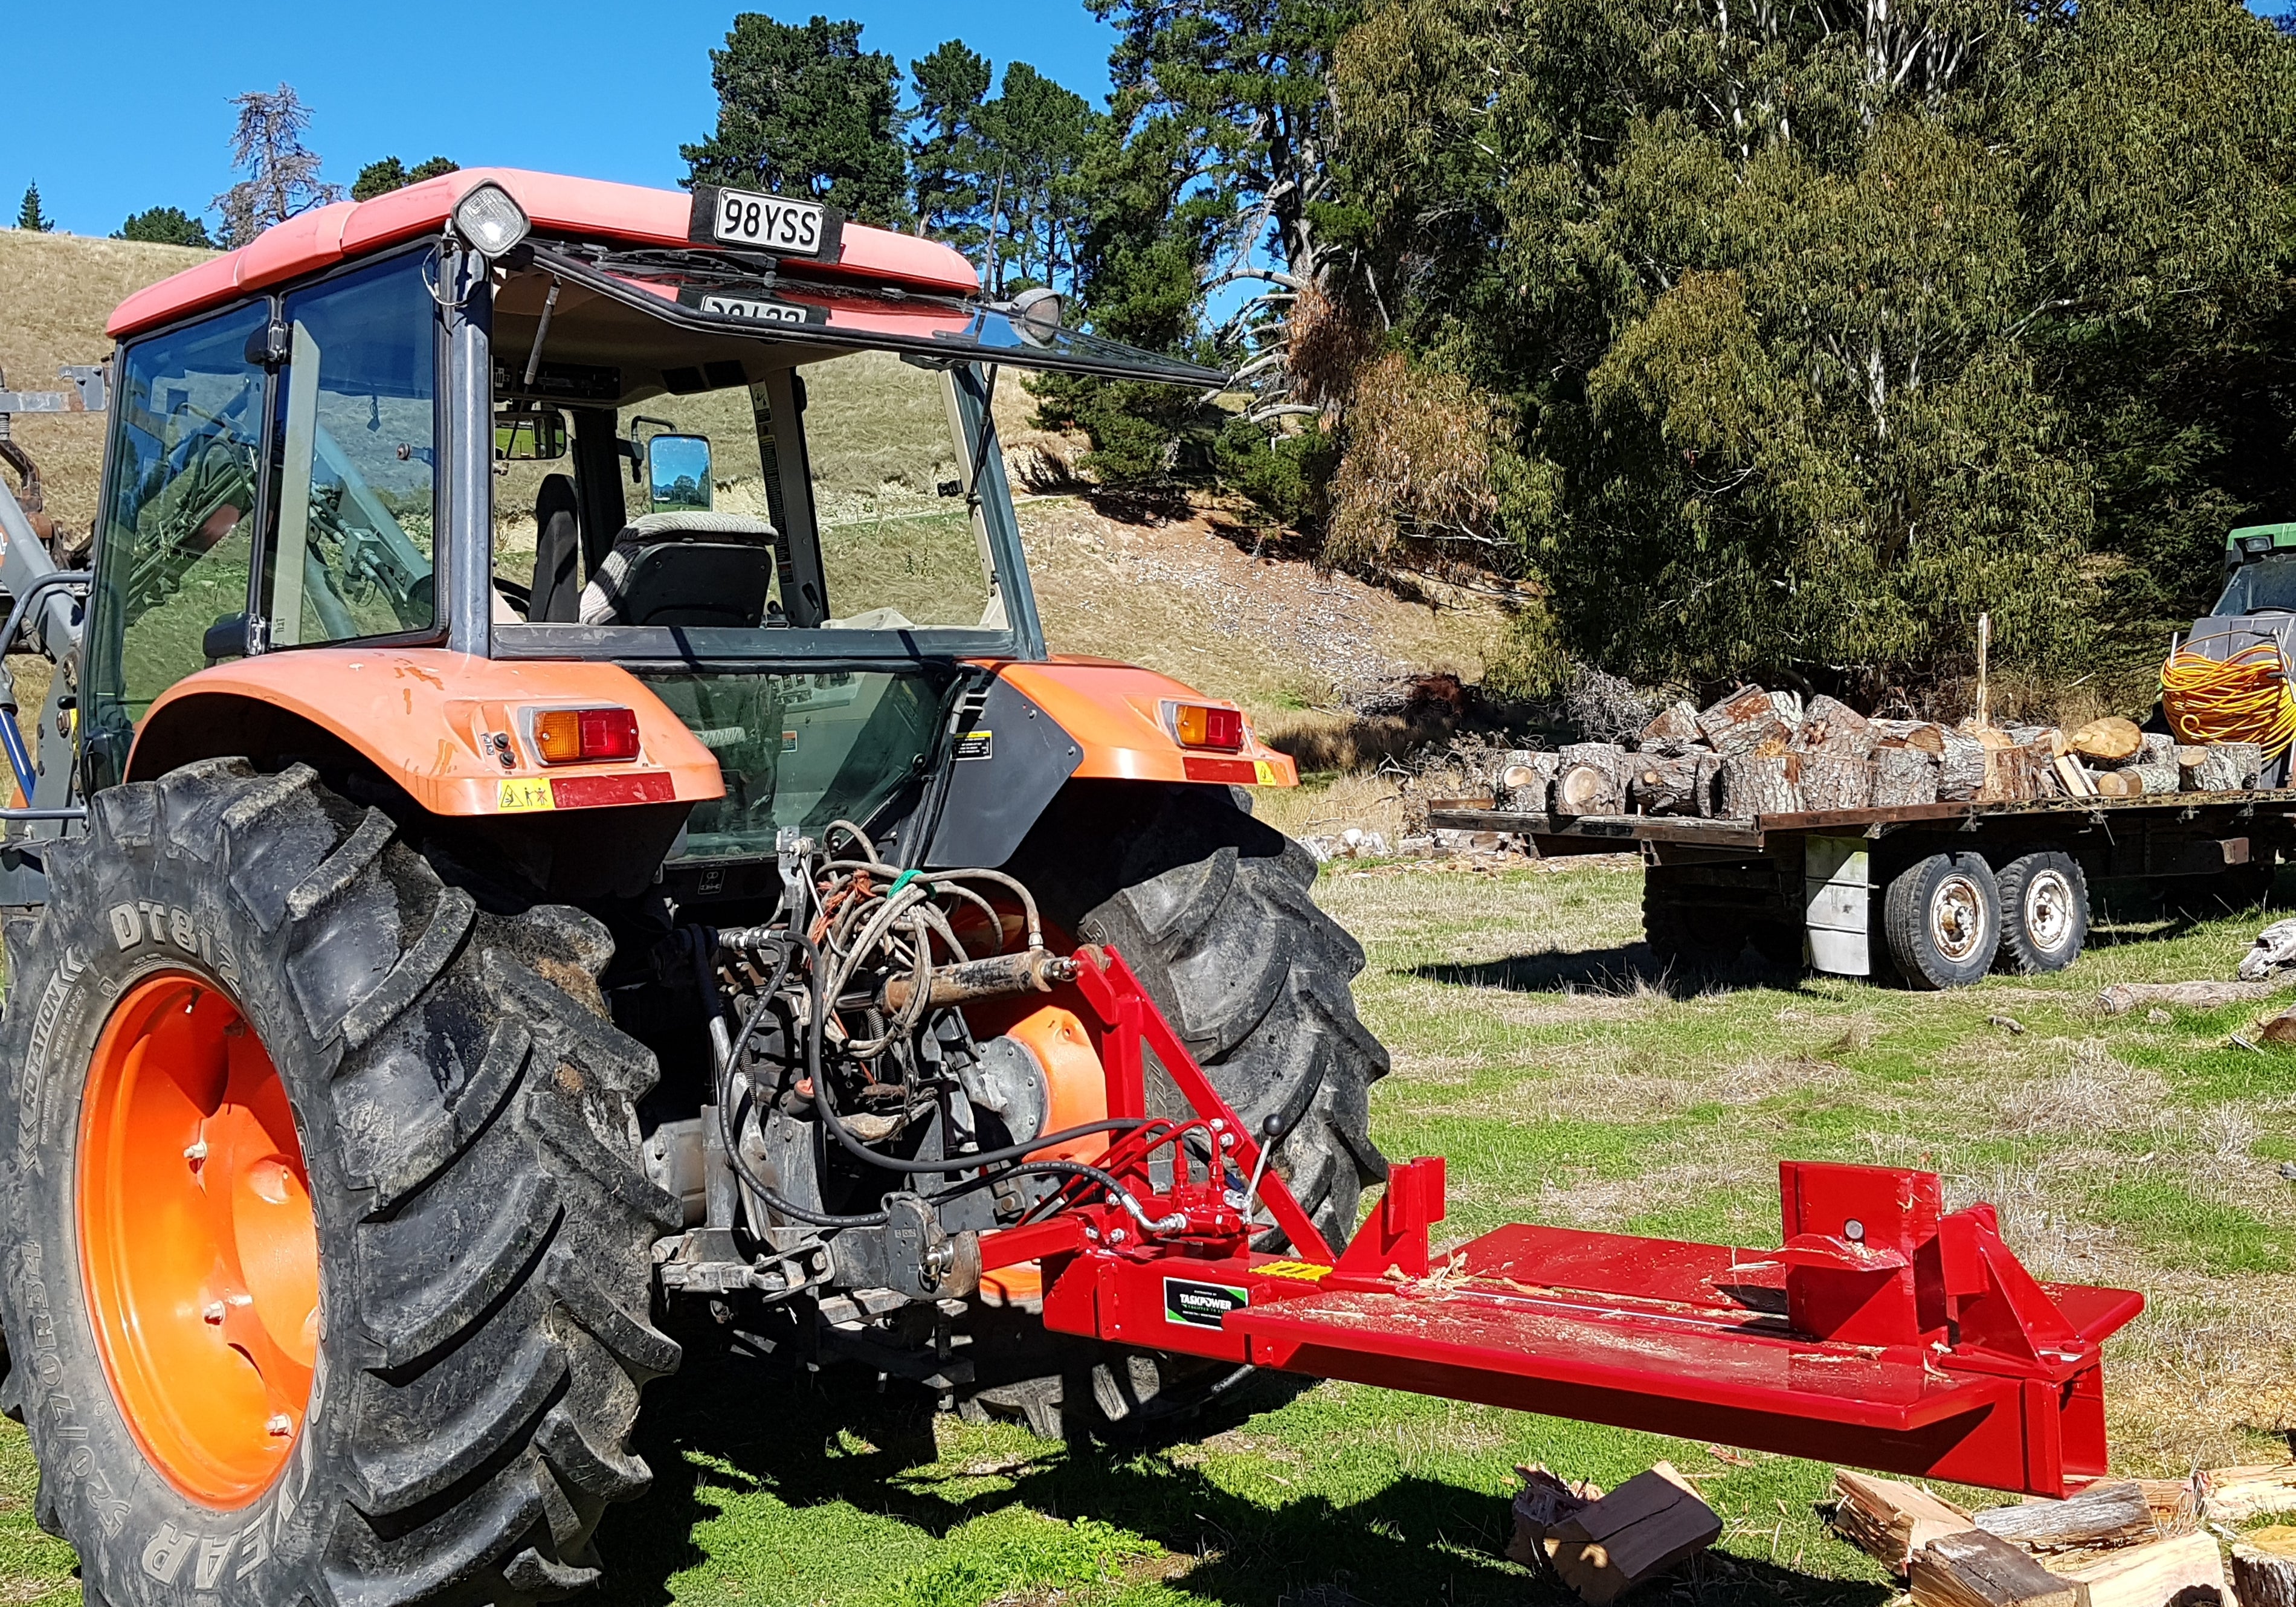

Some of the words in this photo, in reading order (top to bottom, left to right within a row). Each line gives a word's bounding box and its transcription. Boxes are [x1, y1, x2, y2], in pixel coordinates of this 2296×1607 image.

[724, 198, 817, 246] 98YSS
[109, 901, 242, 1000] DT812
[22, 985, 62, 1114] ROTATION
[1179, 1293, 1232, 1310] TASKPOWER
[20, 1240, 131, 1539] 520/70R34
